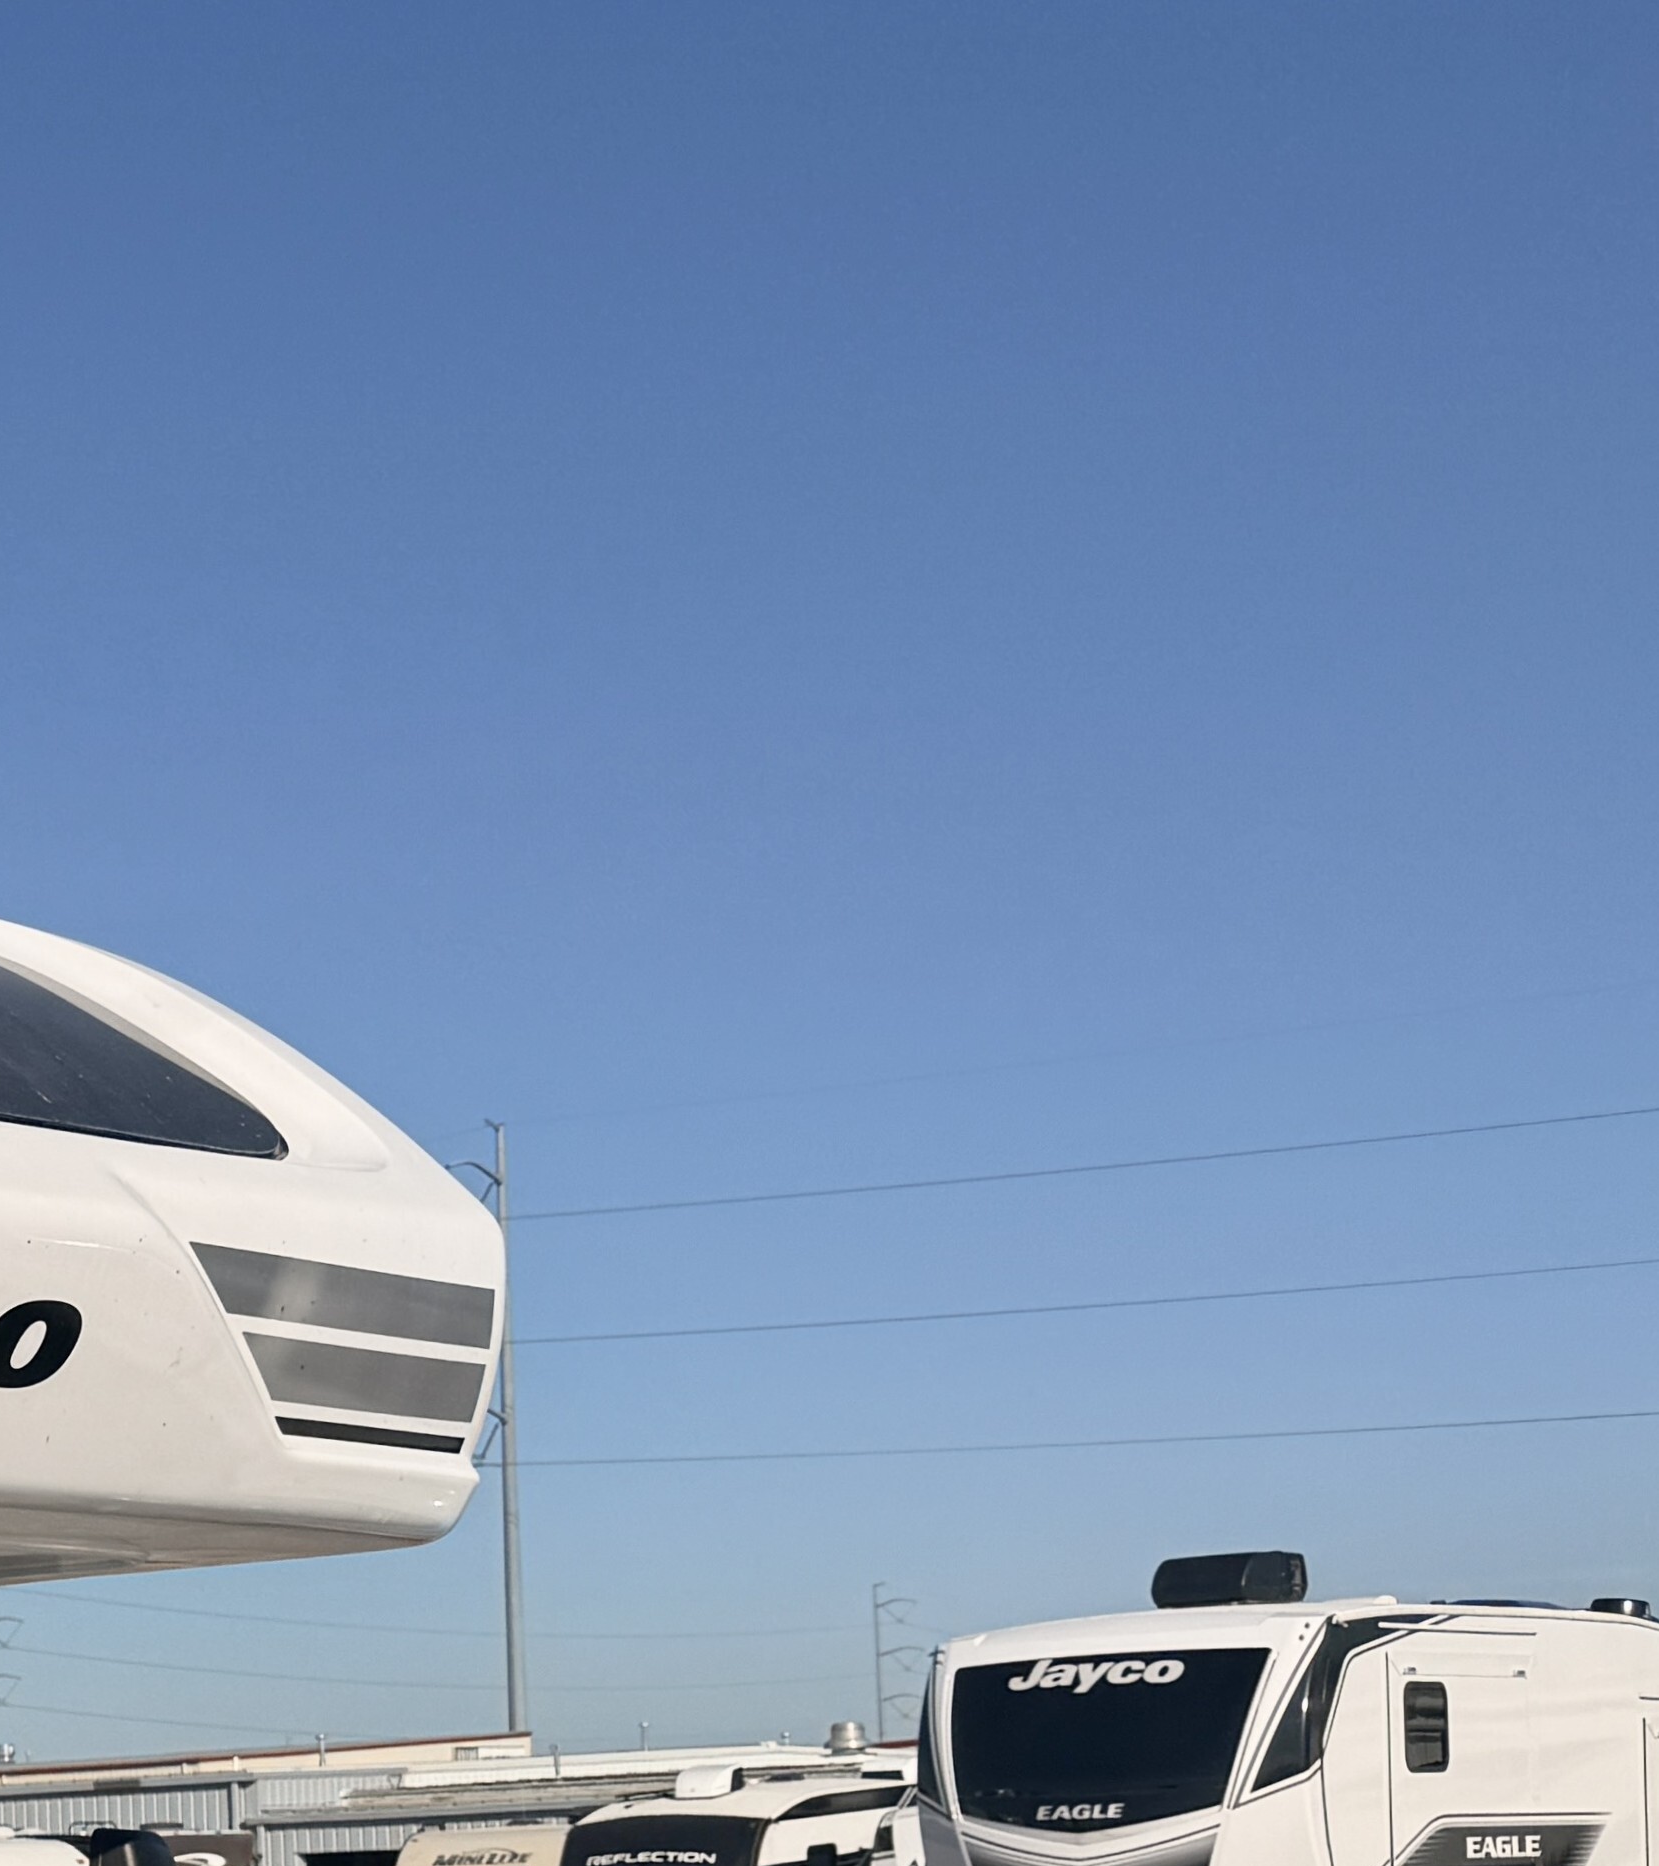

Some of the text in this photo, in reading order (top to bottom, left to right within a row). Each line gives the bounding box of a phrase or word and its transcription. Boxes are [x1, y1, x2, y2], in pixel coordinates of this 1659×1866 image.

[1008, 1658, 1185, 1694] Jayco
[1036, 1803, 1125, 1821] EAGLE
[1465, 1835, 1542, 1858] EAGLE
[585, 1851, 717, 1866] REFLECTION
